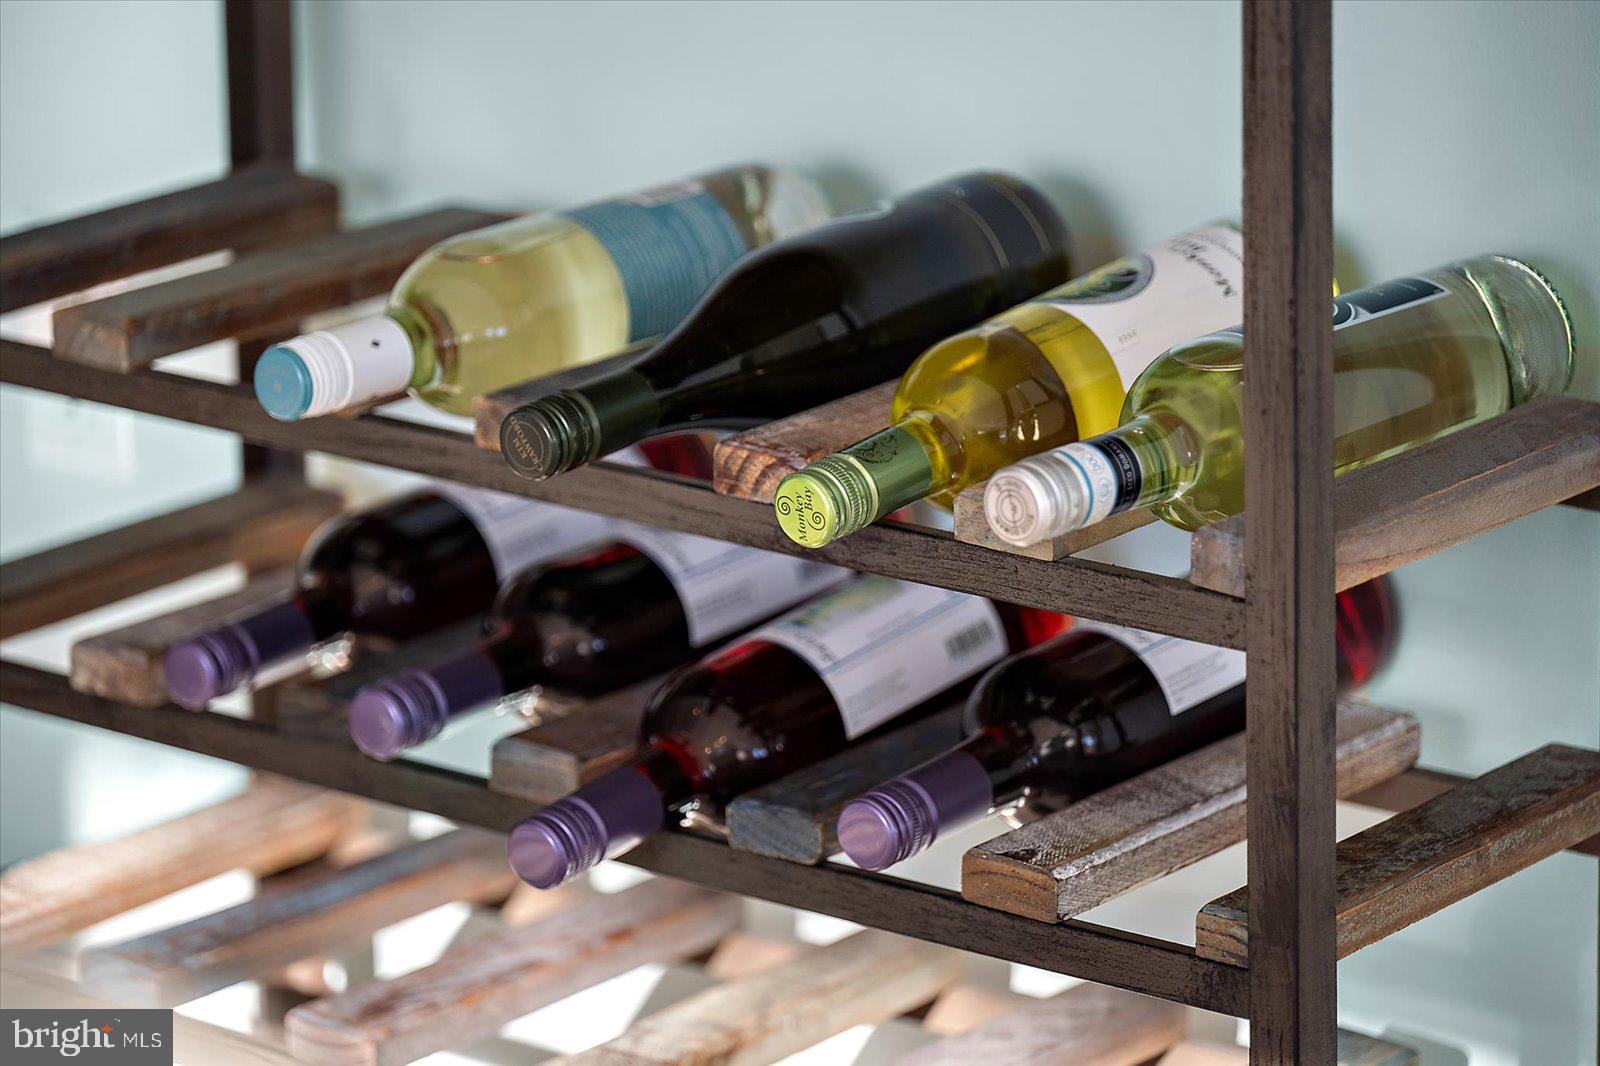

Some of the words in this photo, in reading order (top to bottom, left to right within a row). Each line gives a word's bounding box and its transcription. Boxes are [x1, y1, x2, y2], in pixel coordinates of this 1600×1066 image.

[510, 416, 543, 471] CRAWFORD
[512, 436, 528, 460] KIM
[795, 491, 807, 542] Monkey
[804, 486, 814, 512] Bay
